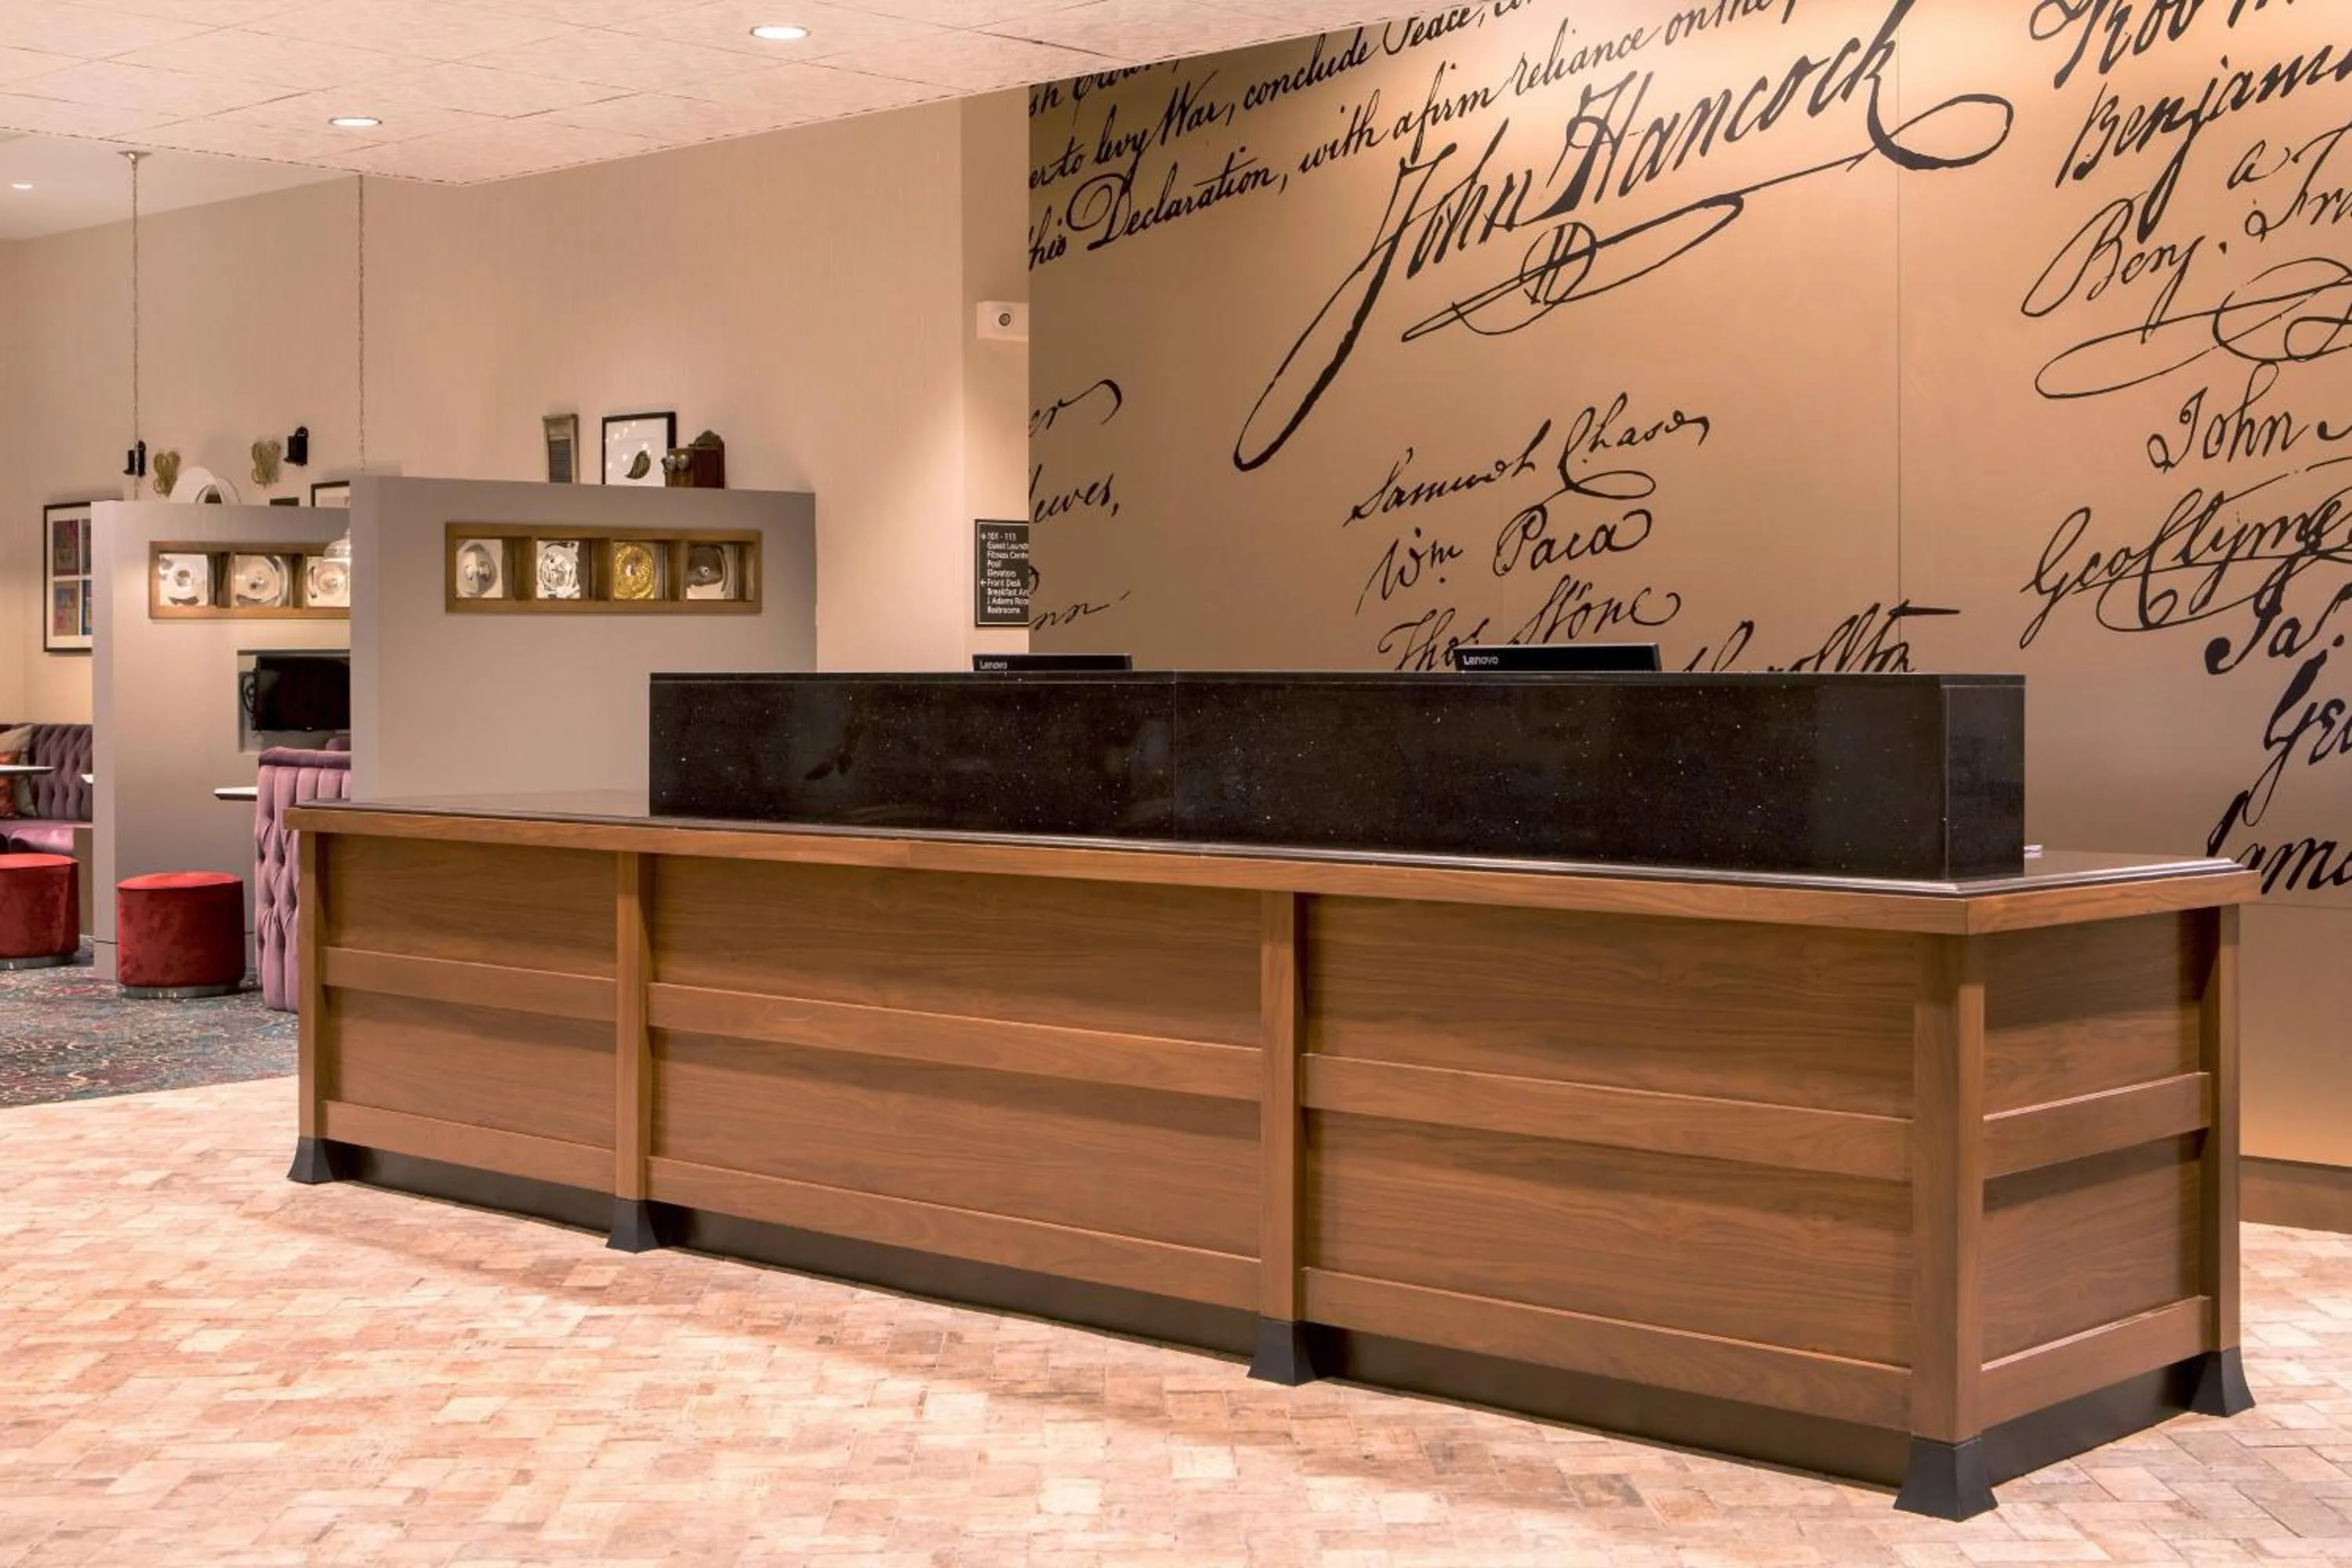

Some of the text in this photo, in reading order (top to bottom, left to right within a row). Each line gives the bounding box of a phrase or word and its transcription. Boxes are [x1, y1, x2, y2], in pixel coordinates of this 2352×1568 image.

[1243, 26, 1379, 111] conclude
[1298, 88, 1389, 173] with
[1234, 0, 2014, 472] John Hancock
[987, 578, 1004, 586] Front
[1463, 655, 1499, 666] Lenovo
